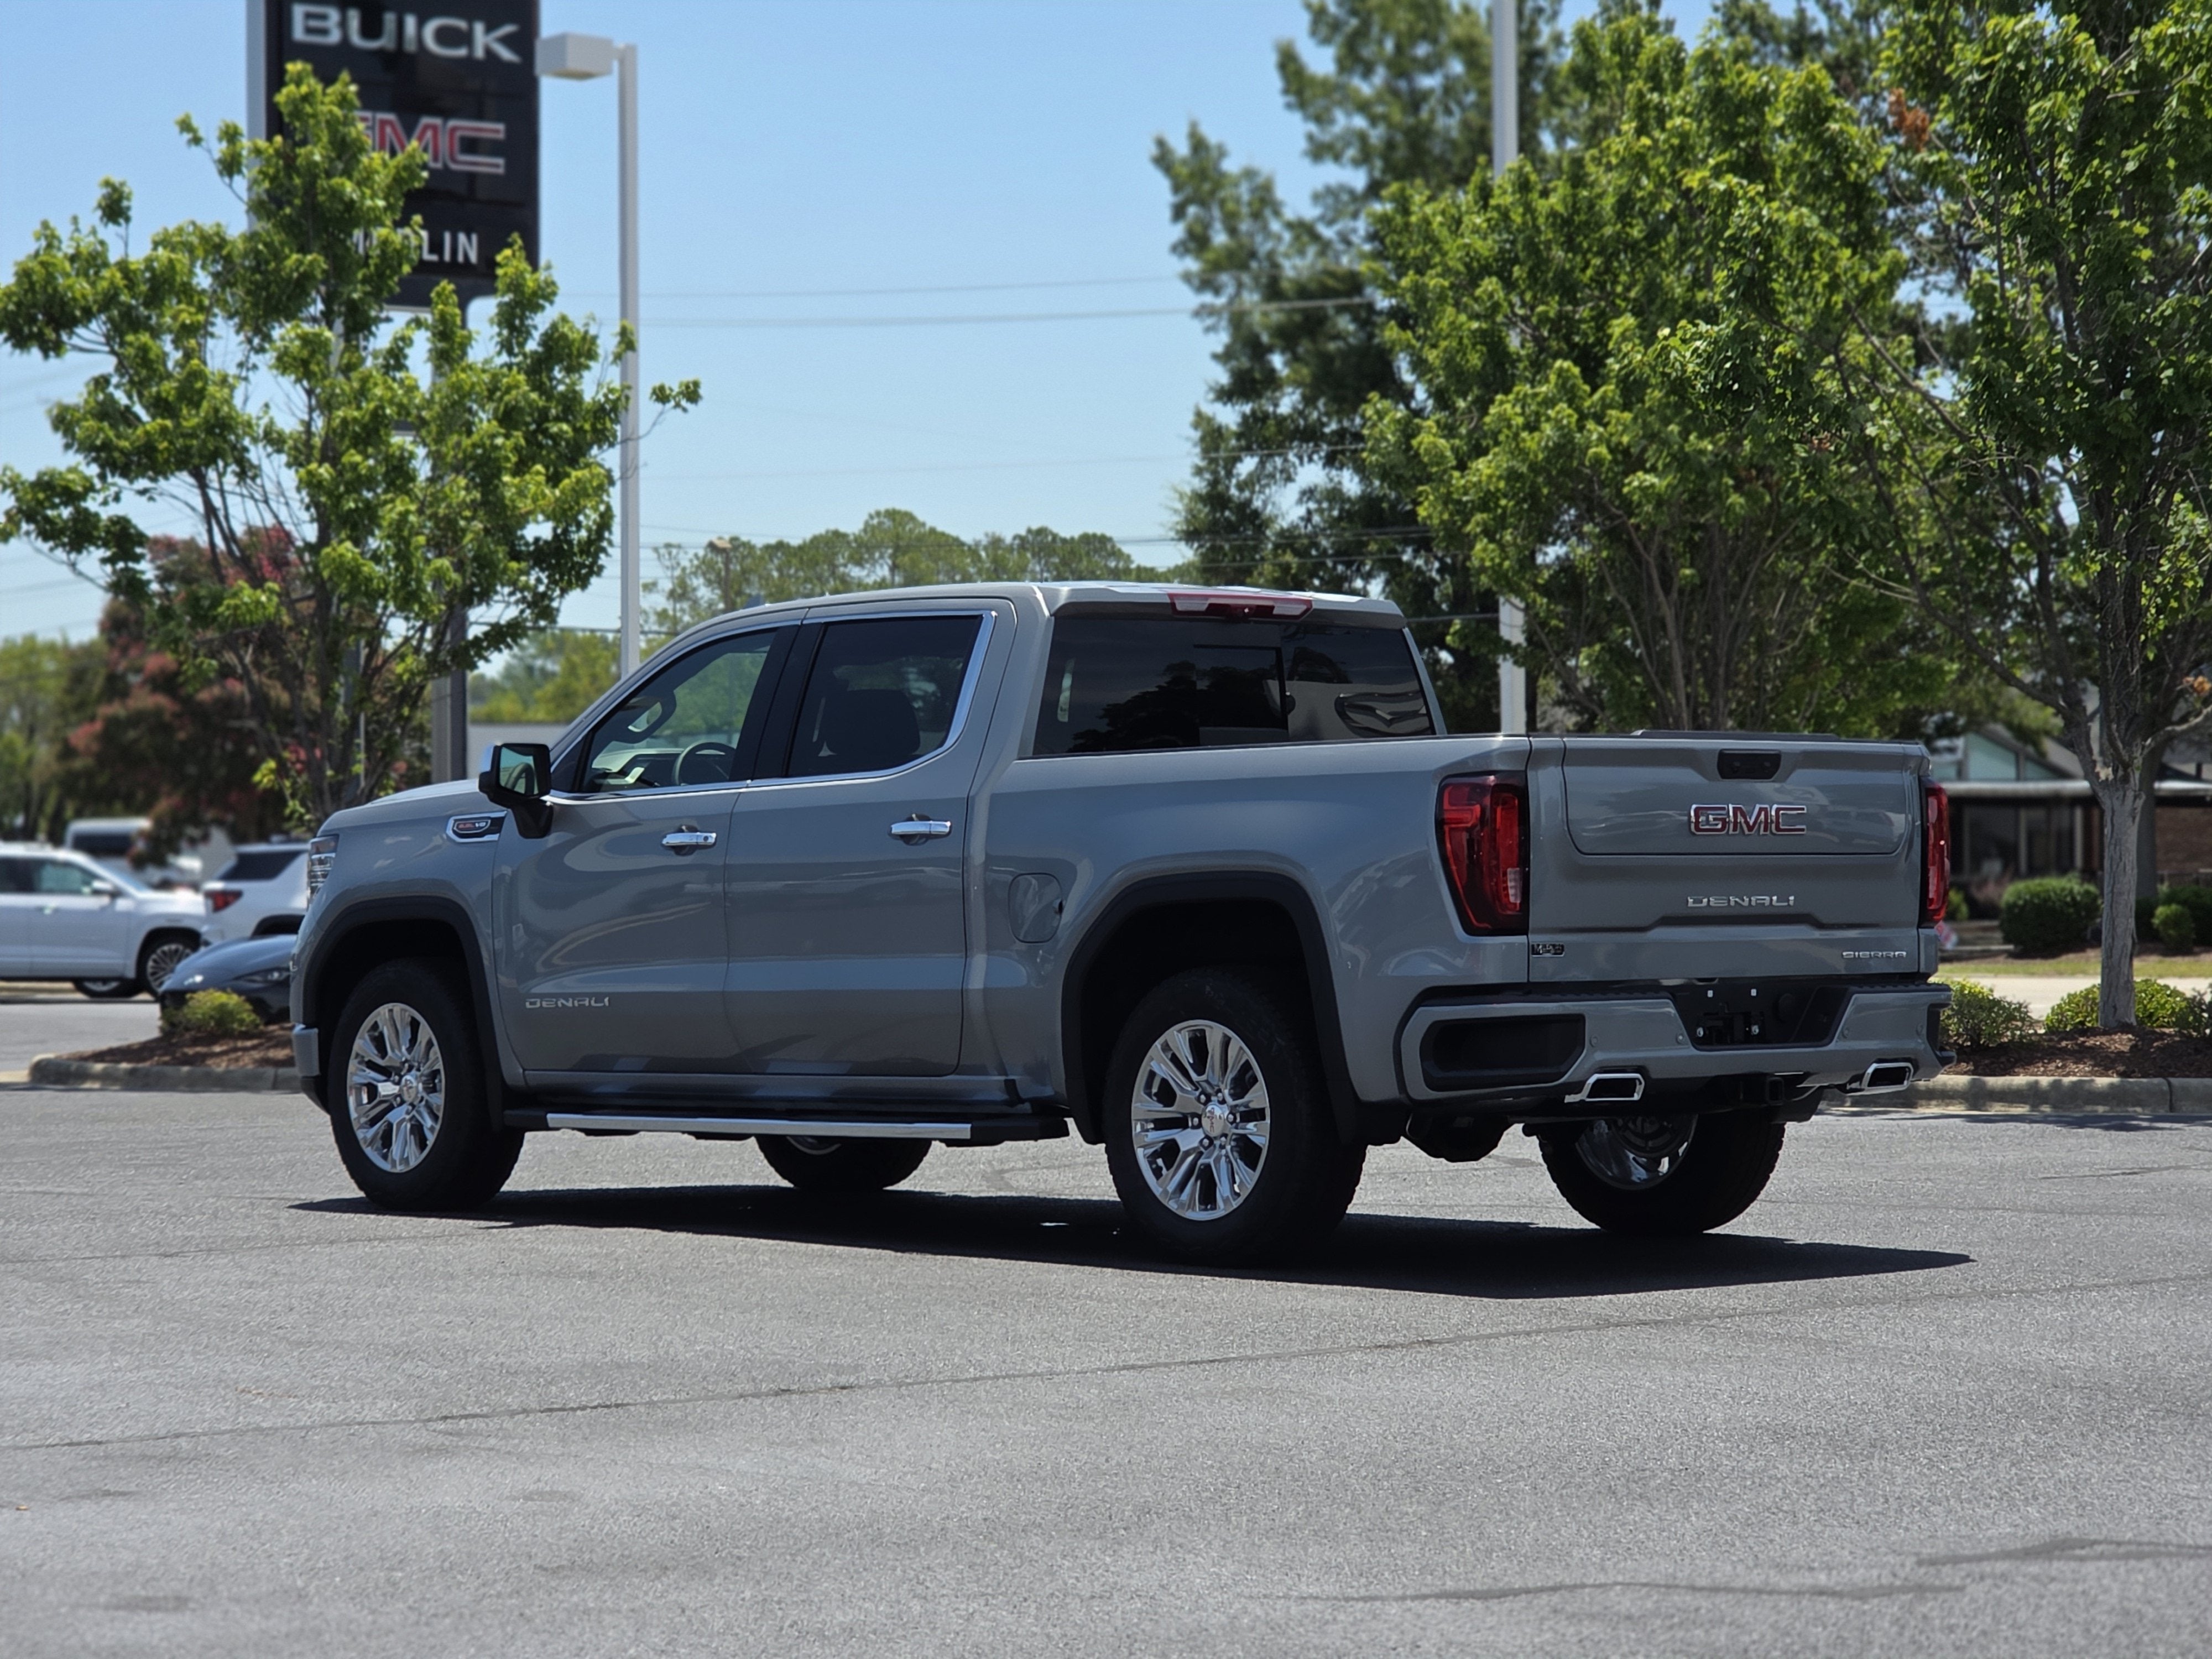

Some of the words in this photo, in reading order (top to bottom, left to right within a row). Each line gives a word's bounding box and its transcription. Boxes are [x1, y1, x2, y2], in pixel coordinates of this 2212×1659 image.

[291, 2, 521, 64] BUICK
[355, 111, 505, 174] MC
[1691, 804, 1807, 834] GMC
[1688, 895, 1794, 907] DENALI
[525, 997, 609, 1009] DENALI
